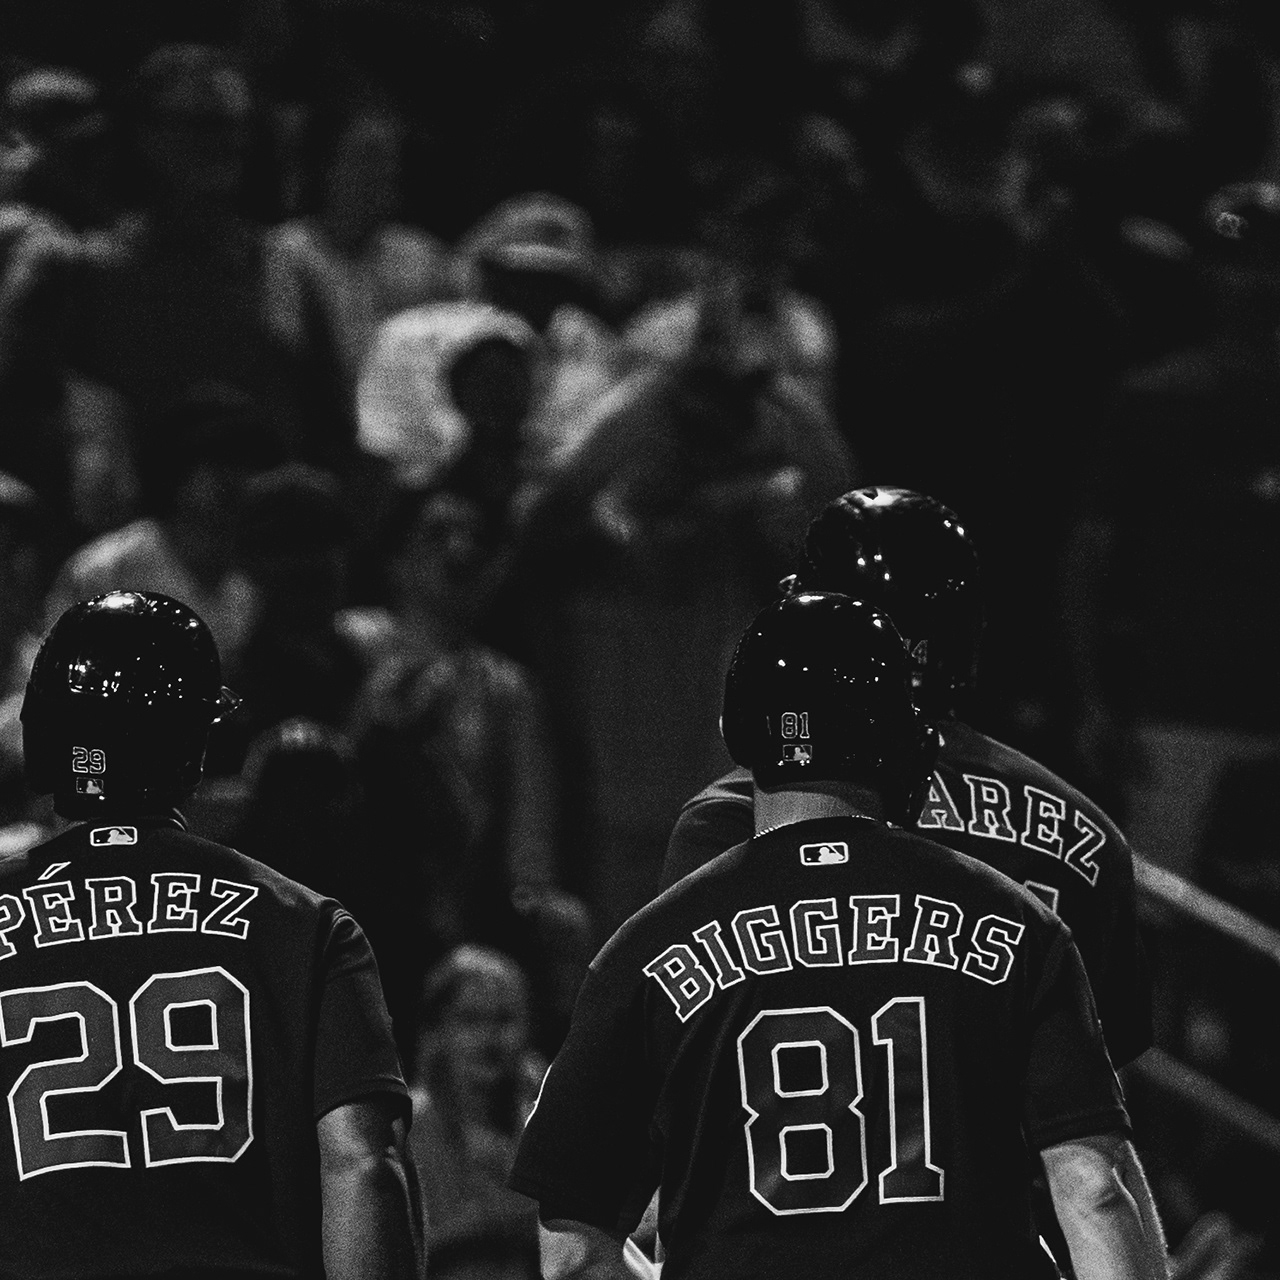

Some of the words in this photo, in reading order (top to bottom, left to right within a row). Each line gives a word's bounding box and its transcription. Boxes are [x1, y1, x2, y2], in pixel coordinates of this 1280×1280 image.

[72, 746, 106, 775] 29
[781, 711, 810, 739] 81
[917, 770, 1107, 887] AREZ
[642, 893, 1025, 1023] BIGGERS
[736, 996, 945, 1217] 81
